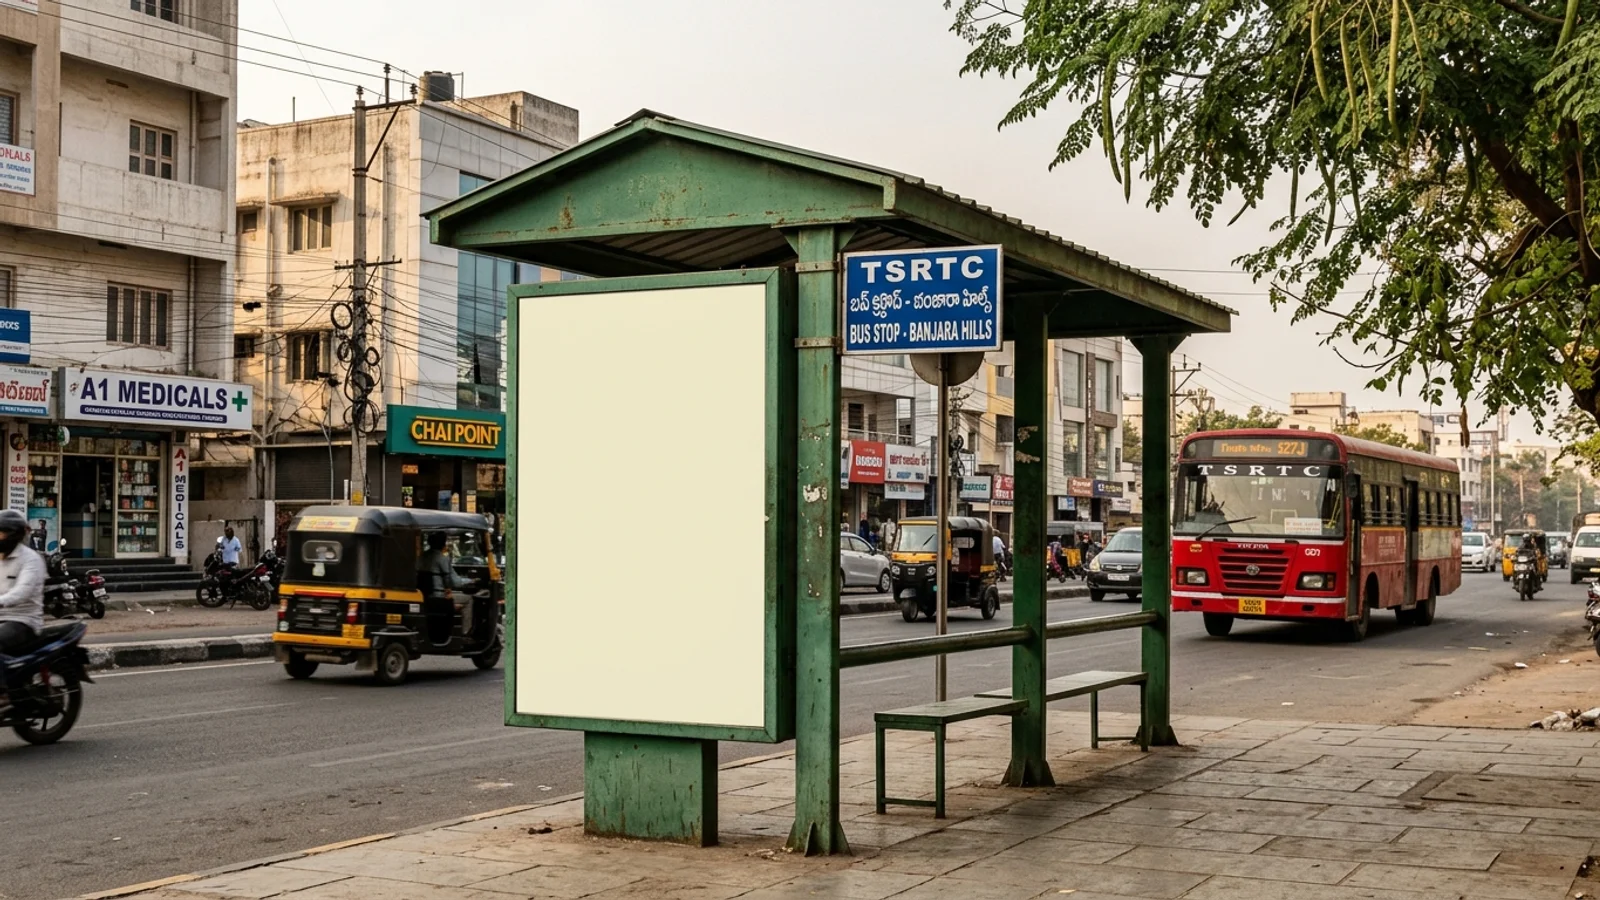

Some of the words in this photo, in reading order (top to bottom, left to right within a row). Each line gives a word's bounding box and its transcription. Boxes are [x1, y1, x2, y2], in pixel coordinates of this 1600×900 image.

[860, 255, 984, 284] TSRTC
[850, 323, 871, 344] BUS
[873, 322, 900, 343] STOP
[909, 320, 959, 342] BANJARA
[961, 318, 992, 341] HILLS
[80, 376, 109, 401] A1
[118, 379, 228, 411] MEDICALS
[411, 420, 452, 441] CHAI
[455, 423, 502, 445] POINT
[1197, 464, 1321, 477] TSRTC
